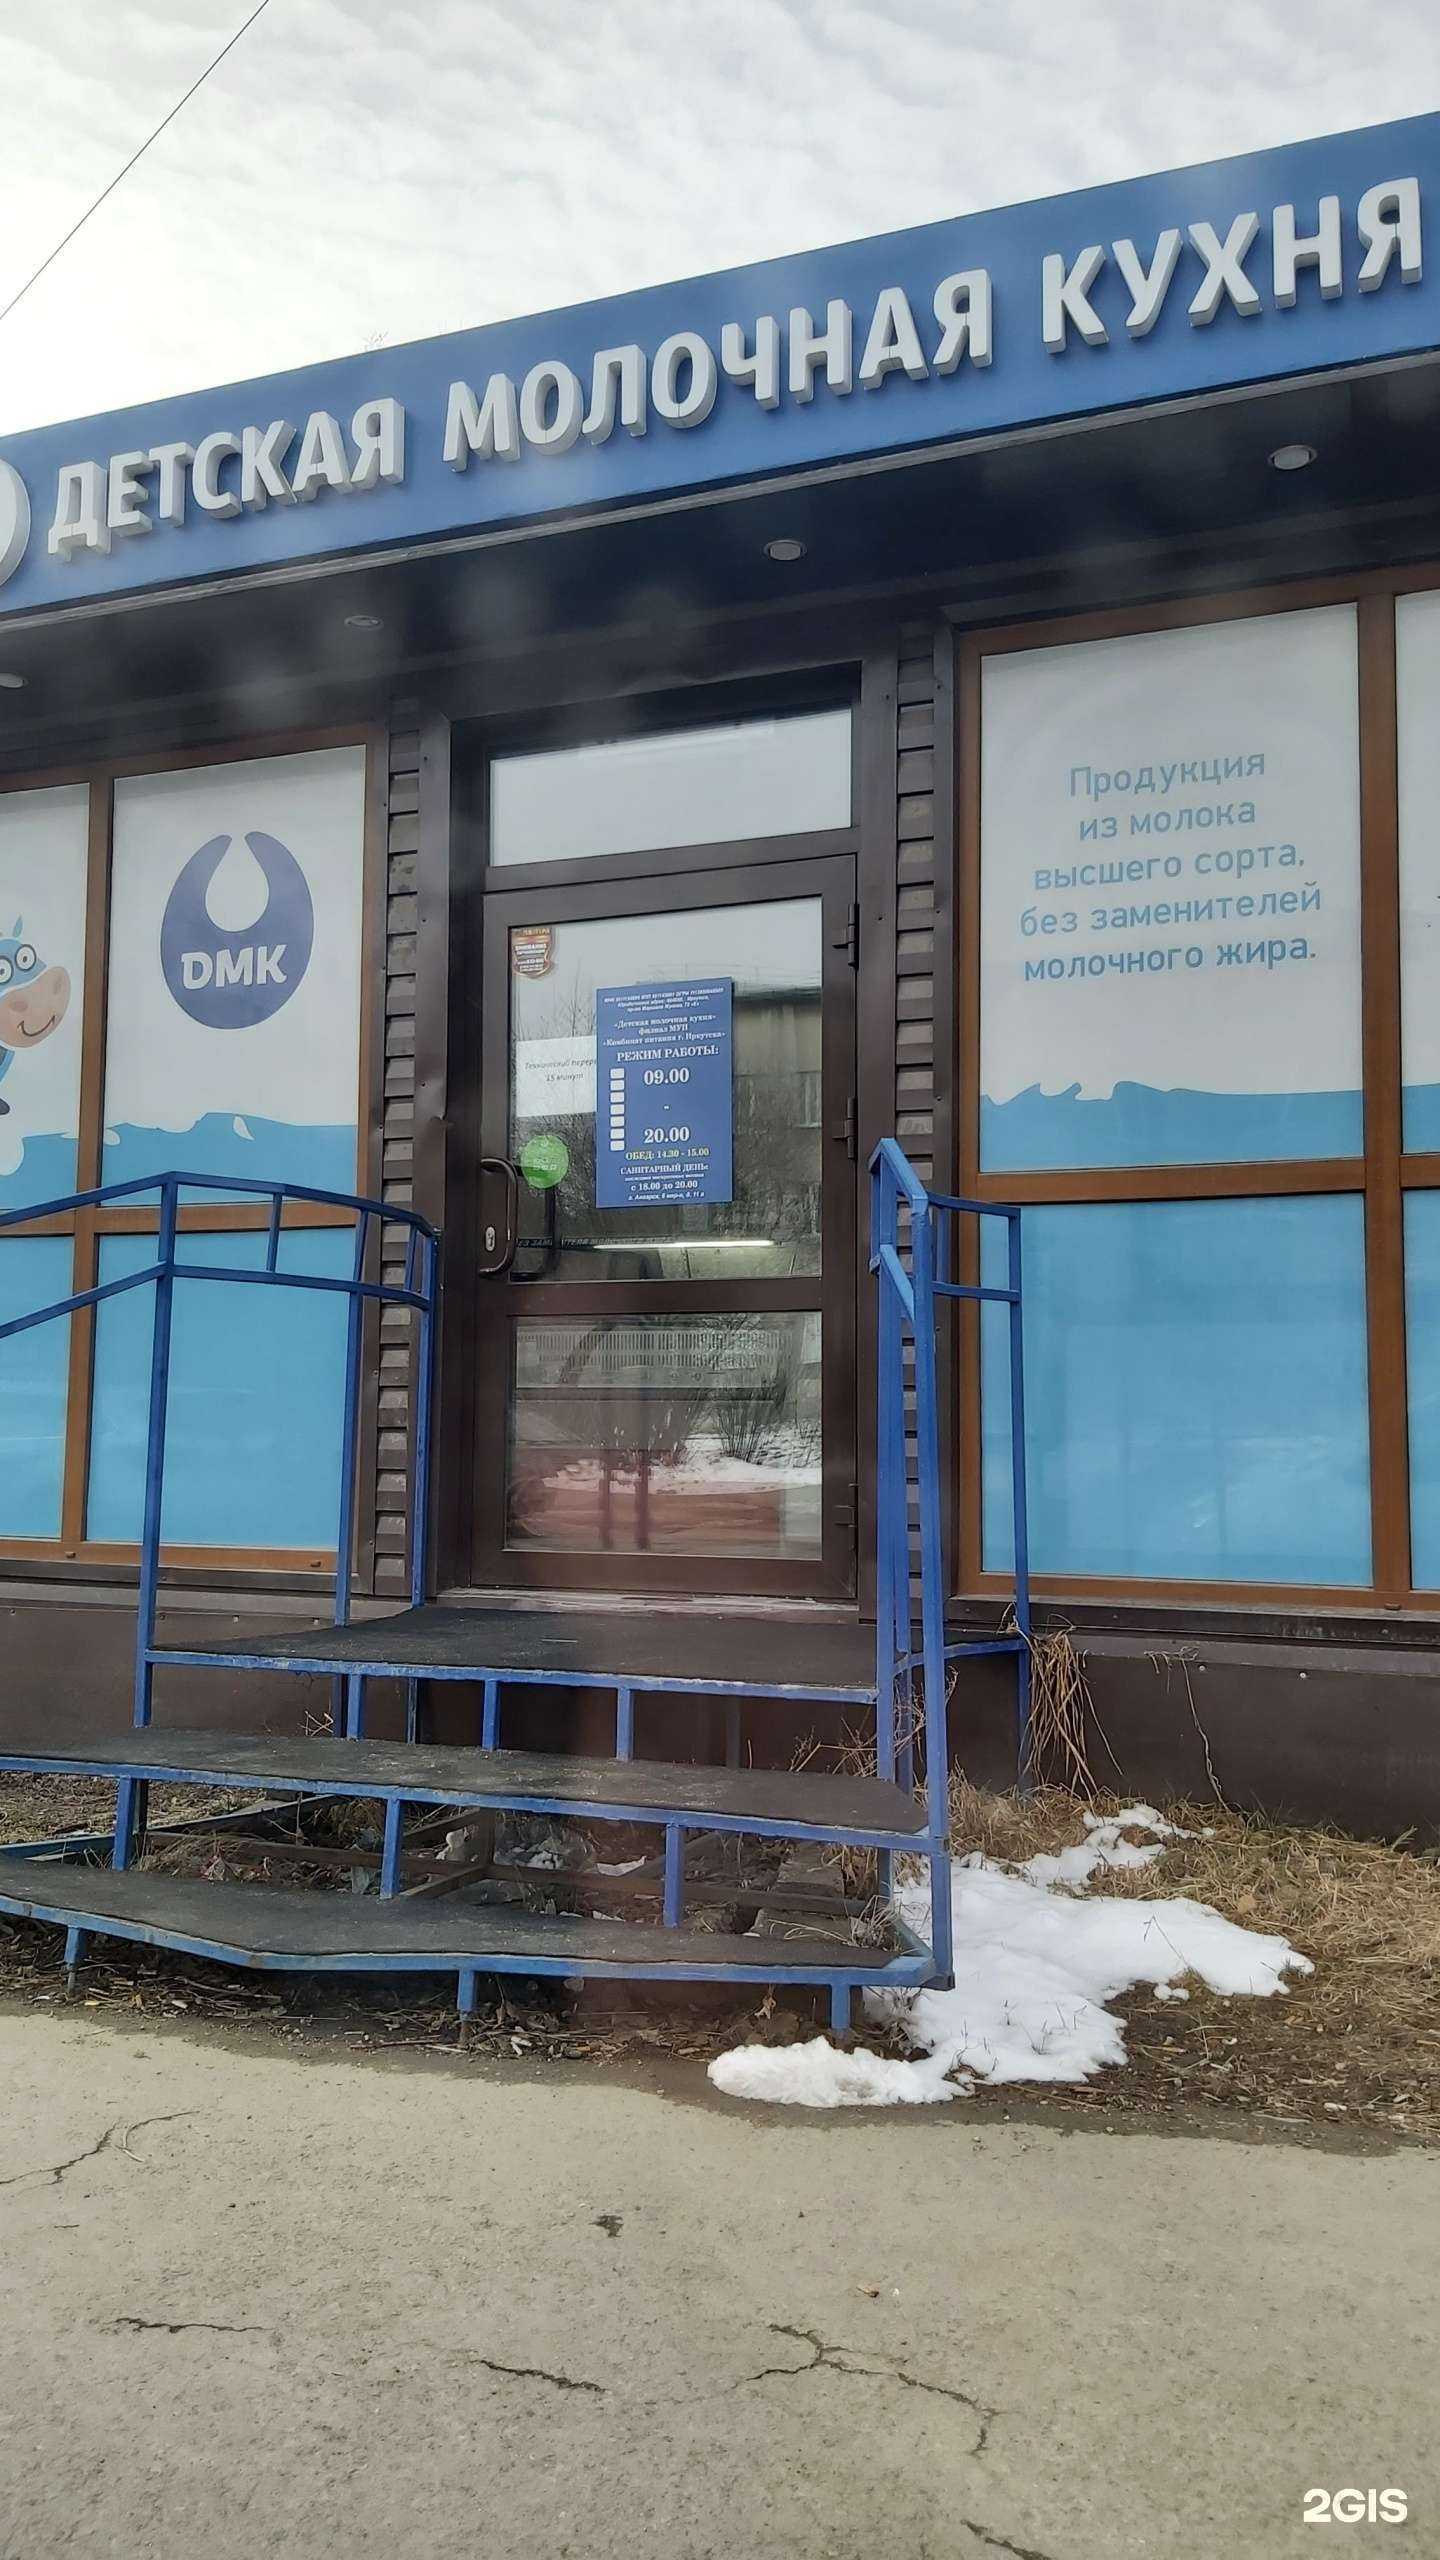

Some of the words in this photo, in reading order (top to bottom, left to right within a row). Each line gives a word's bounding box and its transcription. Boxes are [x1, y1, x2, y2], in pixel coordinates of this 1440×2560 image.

[48, 397, 406, 561] ДЕТСКАЯ
[442, 268, 993, 473] МОЛОЧНАЯ
[1042, 176, 1423, 355] КУХНЯ
[1068, 752, 1267, 802] Продукция
[1078, 814, 1119, 842] из
[1129, 800, 1257, 837] молока
[1033, 854, 1183, 891] высшего
[1019, 905, 1079, 938] без
[1089, 880, 1322, 932] заменителей
[180, 943, 289, 991] DMK
[1023, 944, 1204, 982] молочного
[1215, 935, 1318, 970] жира.
[669, 1023, 688, 1033] МУП
[617, 1048, 662, 1062] РЕЖИМ
[664, 1044, 720, 1059] РАБОТЫ:
[644, 1067, 690, 1085] 09.00
[644, 1126, 690, 1144] 20.00
[625, 1150, 655, 1161] ОБЕД:
[656, 1148, 680, 1159] 14.30
[687, 1146, 710, 1157] 15.00
[620, 1162, 681, 1175] САНИТАРНЫЙ
[682, 1162, 709, 1173] ДЕНЬ:
[638, 1180, 661, 1191] 18.00
[662, 1182, 673, 1190] до
[674, 1179, 698, 1189] 20.00
